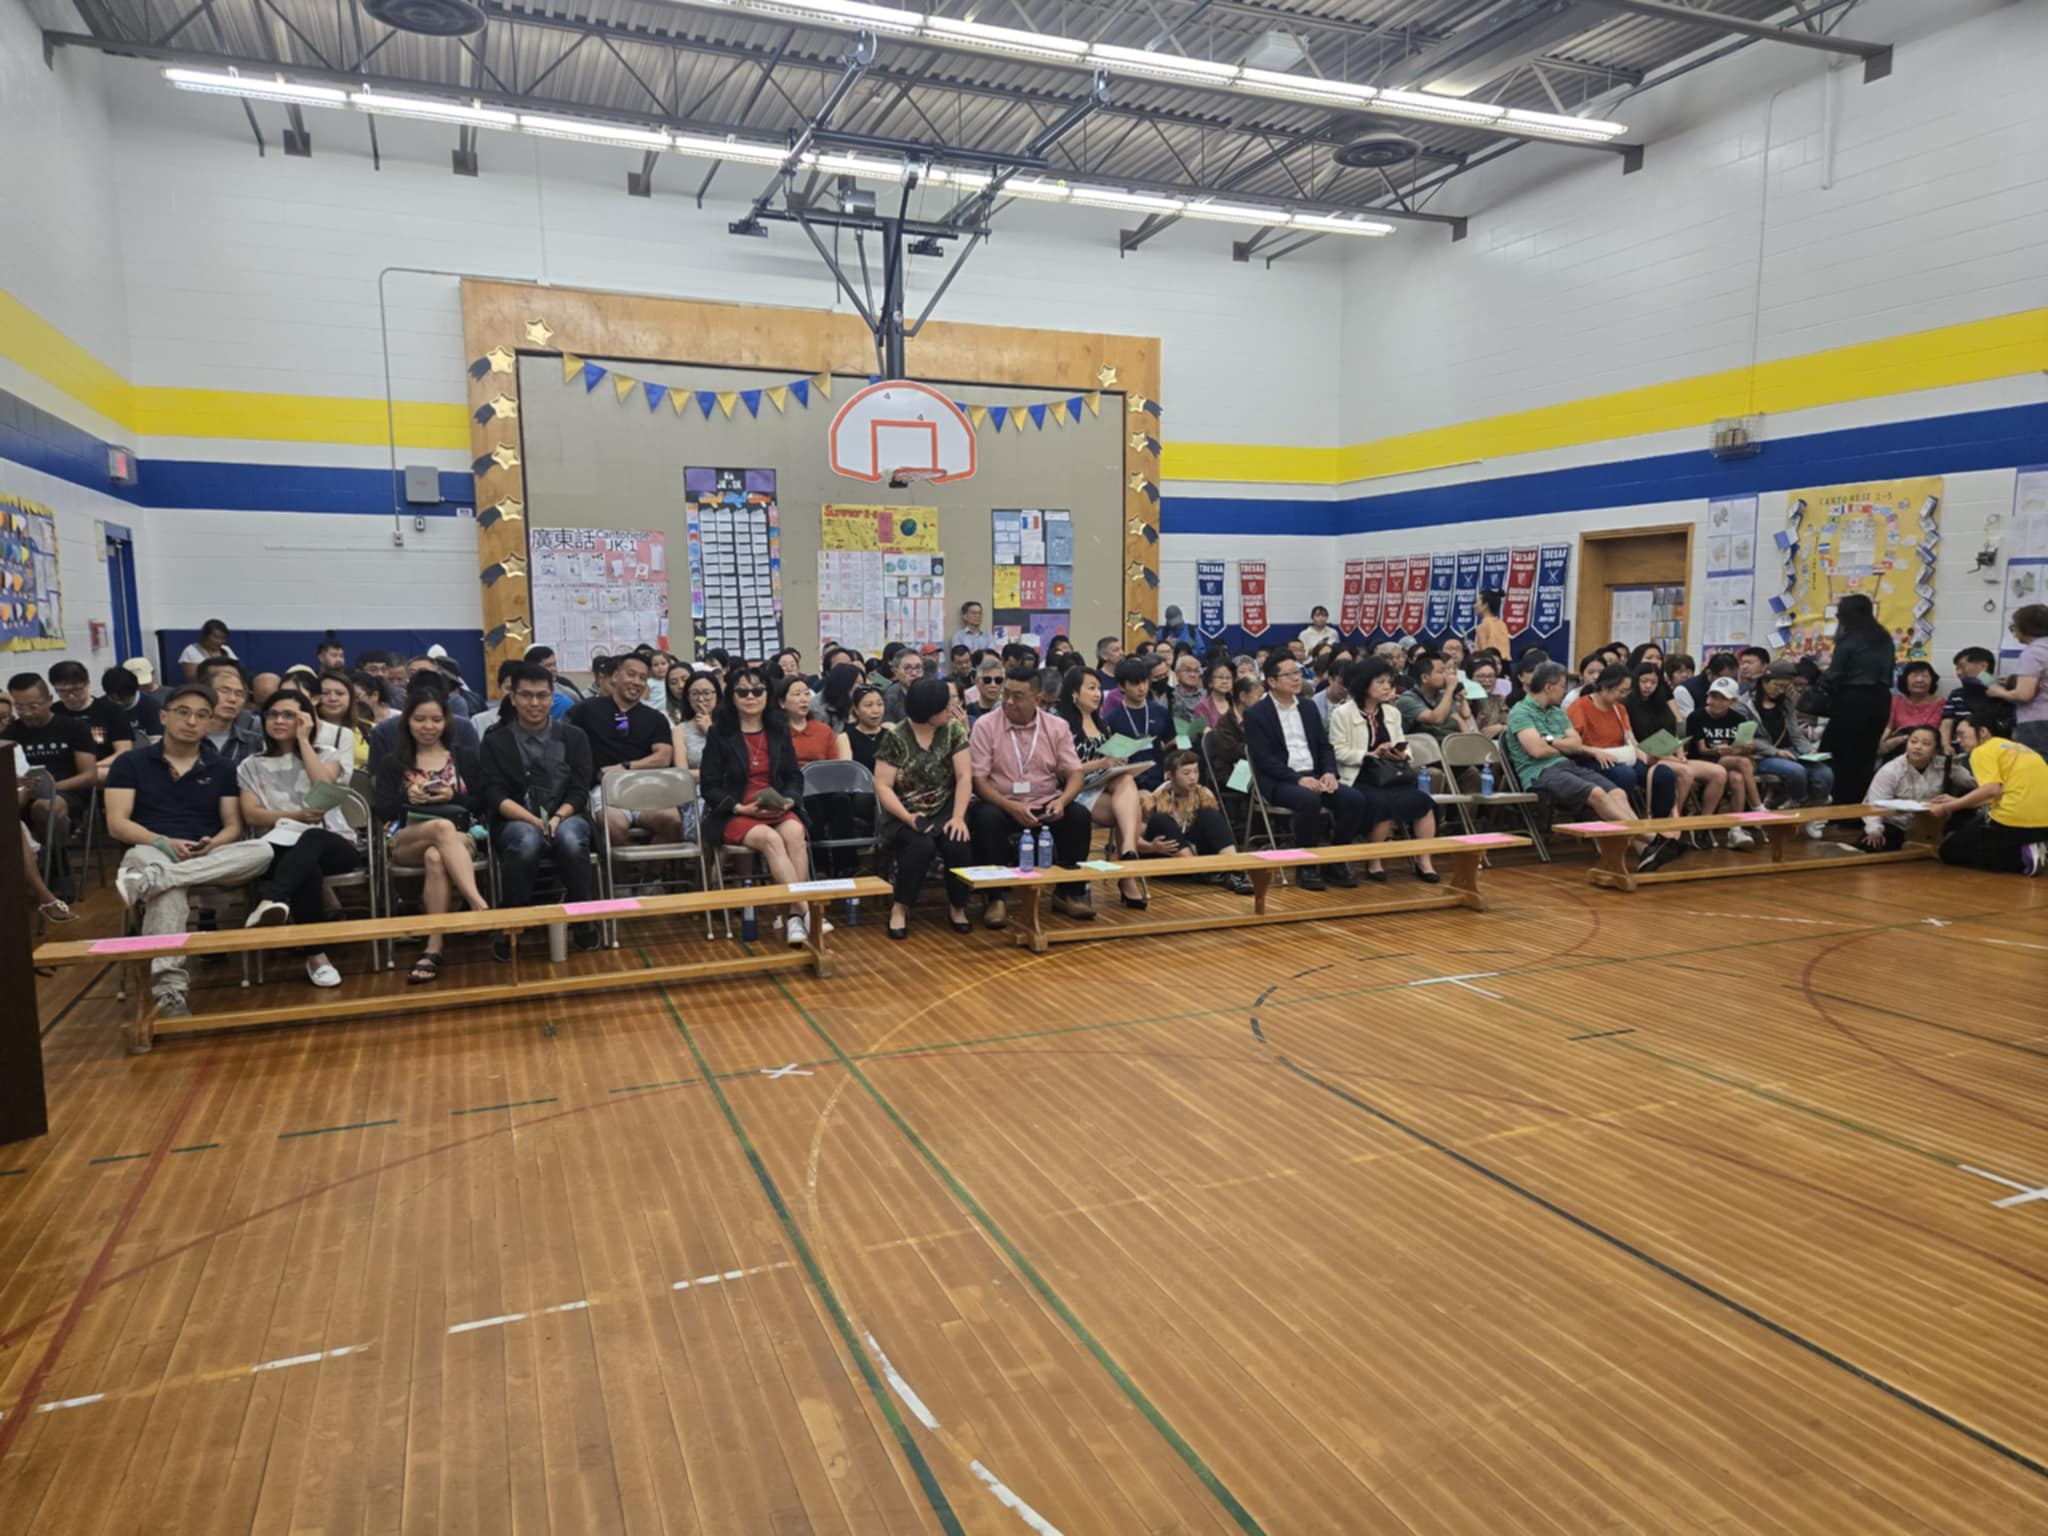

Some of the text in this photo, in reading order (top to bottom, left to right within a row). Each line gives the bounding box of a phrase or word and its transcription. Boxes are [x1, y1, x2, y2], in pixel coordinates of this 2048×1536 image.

[532, 528, 596, 549] 廣東話
[597, 530, 650, 540] Cantonese
[1703, 726, 1738, 738] PARIS
